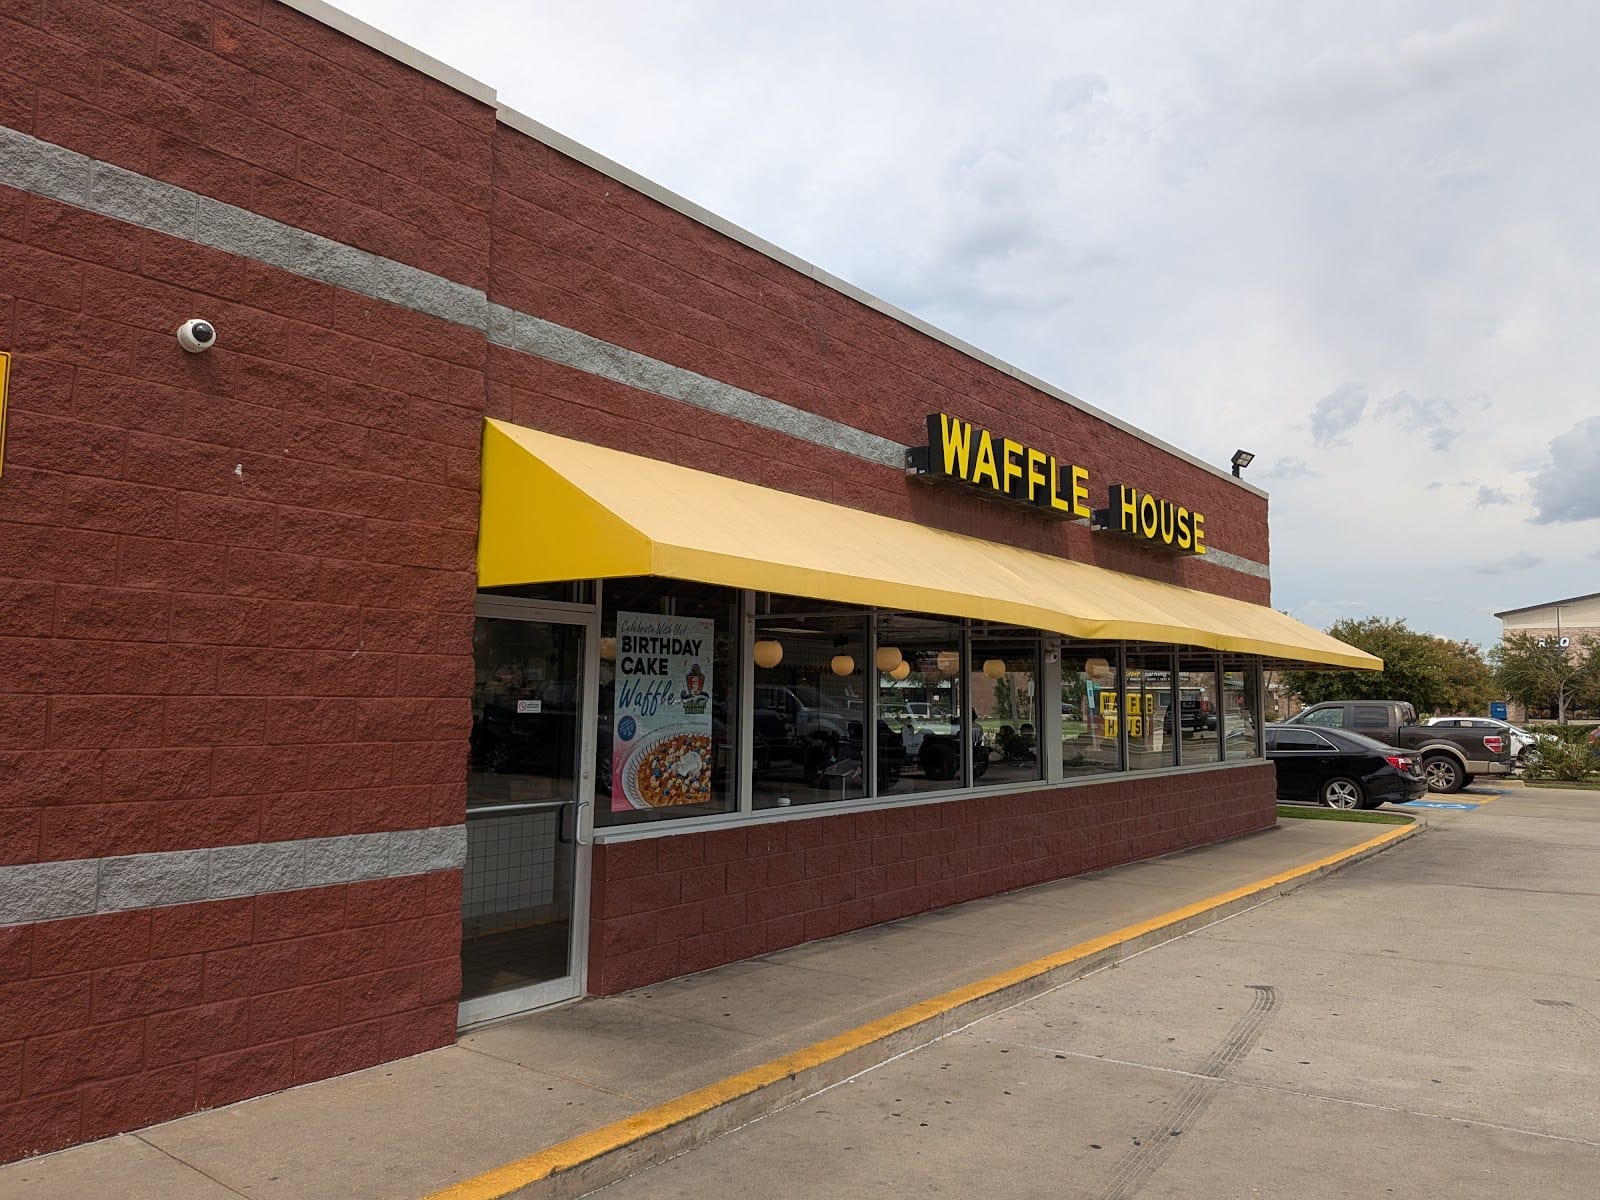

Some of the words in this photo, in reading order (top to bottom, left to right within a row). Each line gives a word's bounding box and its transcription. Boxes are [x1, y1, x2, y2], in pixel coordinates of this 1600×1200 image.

[940, 412, 1091, 518] WAFFLE
[1120, 484, 1207, 554] HOUSE
[621, 635, 702, 656] BIRTHDAY
[621, 656, 669, 675] CAKE
[618, 679, 676, 717] Waffle
